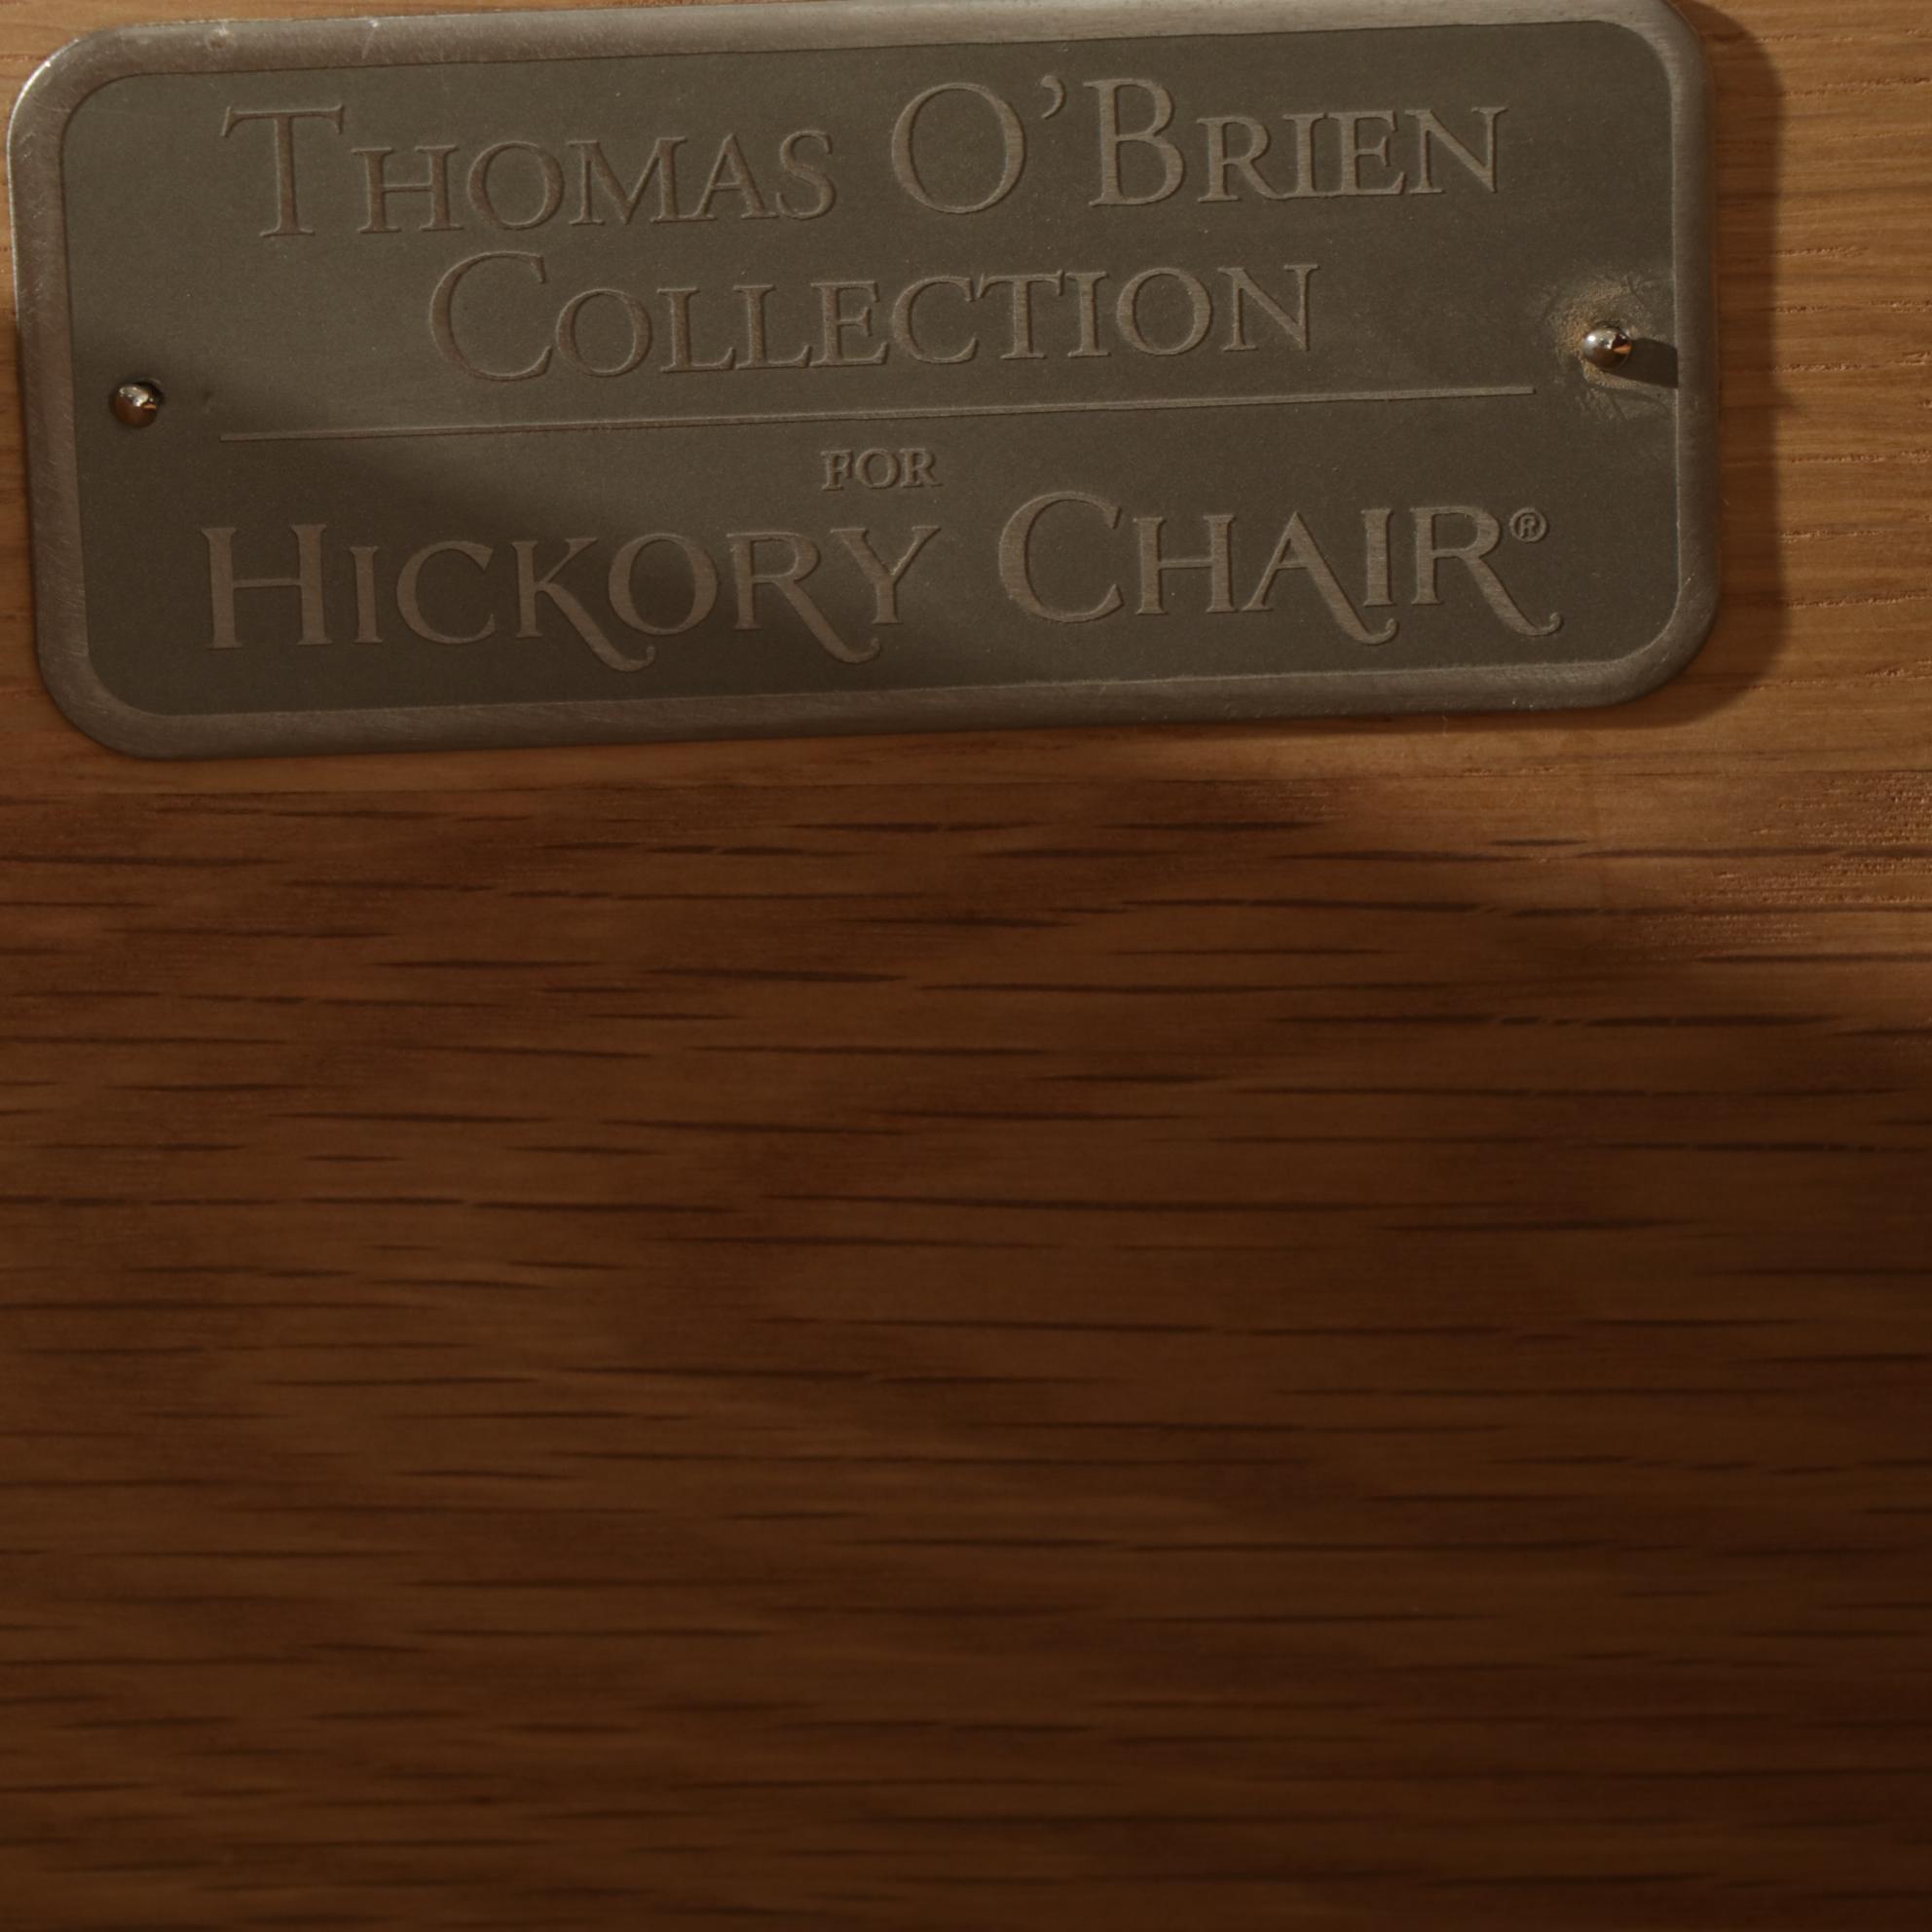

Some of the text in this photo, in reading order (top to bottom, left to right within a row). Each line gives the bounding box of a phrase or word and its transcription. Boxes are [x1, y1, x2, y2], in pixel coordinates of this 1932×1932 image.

[221, 103, 837, 239] THOMAS
[427, 249, 1321, 383] COLLECTION
[819, 446, 942, 492] FOR
[201, 523, 942, 674] HICKORY
